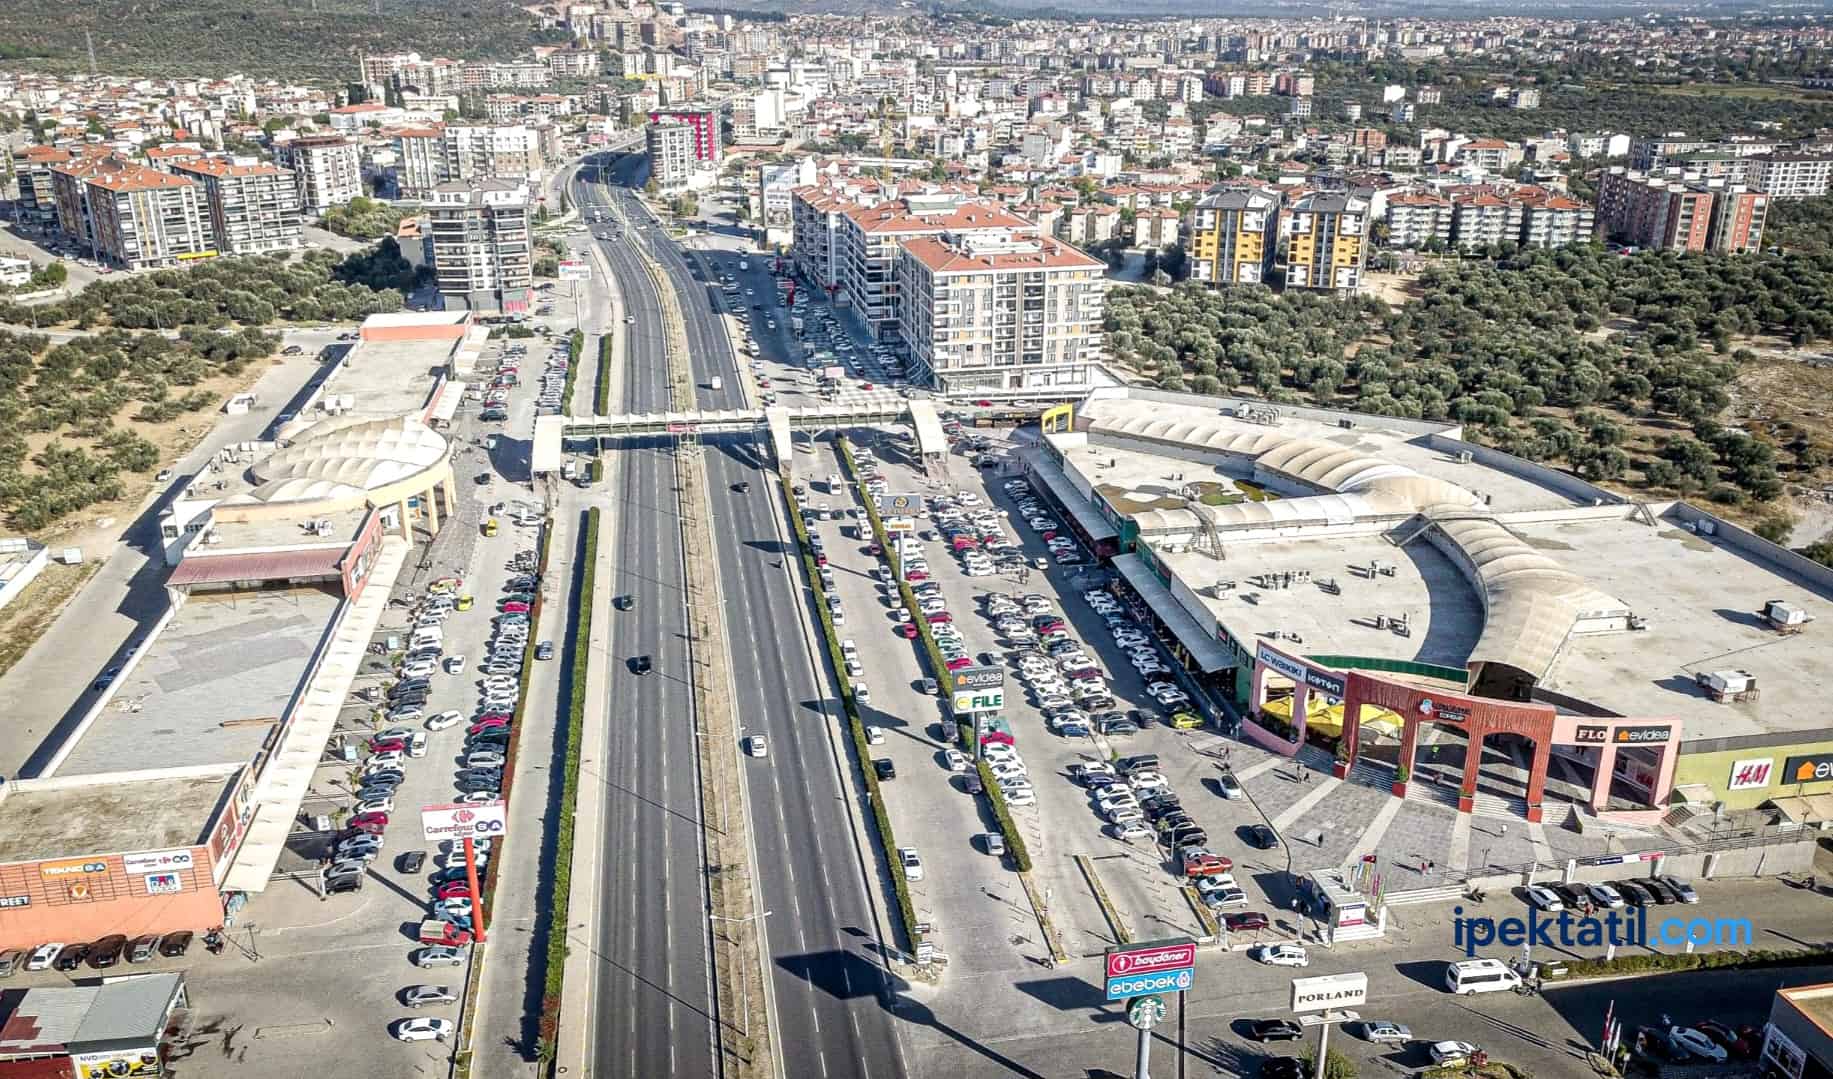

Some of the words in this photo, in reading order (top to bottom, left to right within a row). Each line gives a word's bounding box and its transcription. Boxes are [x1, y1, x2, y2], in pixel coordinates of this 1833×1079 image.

[972, 694, 1002, 708] FILE
[1578, 729, 1606, 739] FLO
[1630, 729, 1669, 740] evidea
[1734, 763, 1770, 785] H&M
[1110, 976, 1176, 995] ebebek
[1298, 989, 1363, 1004] PORLAND
